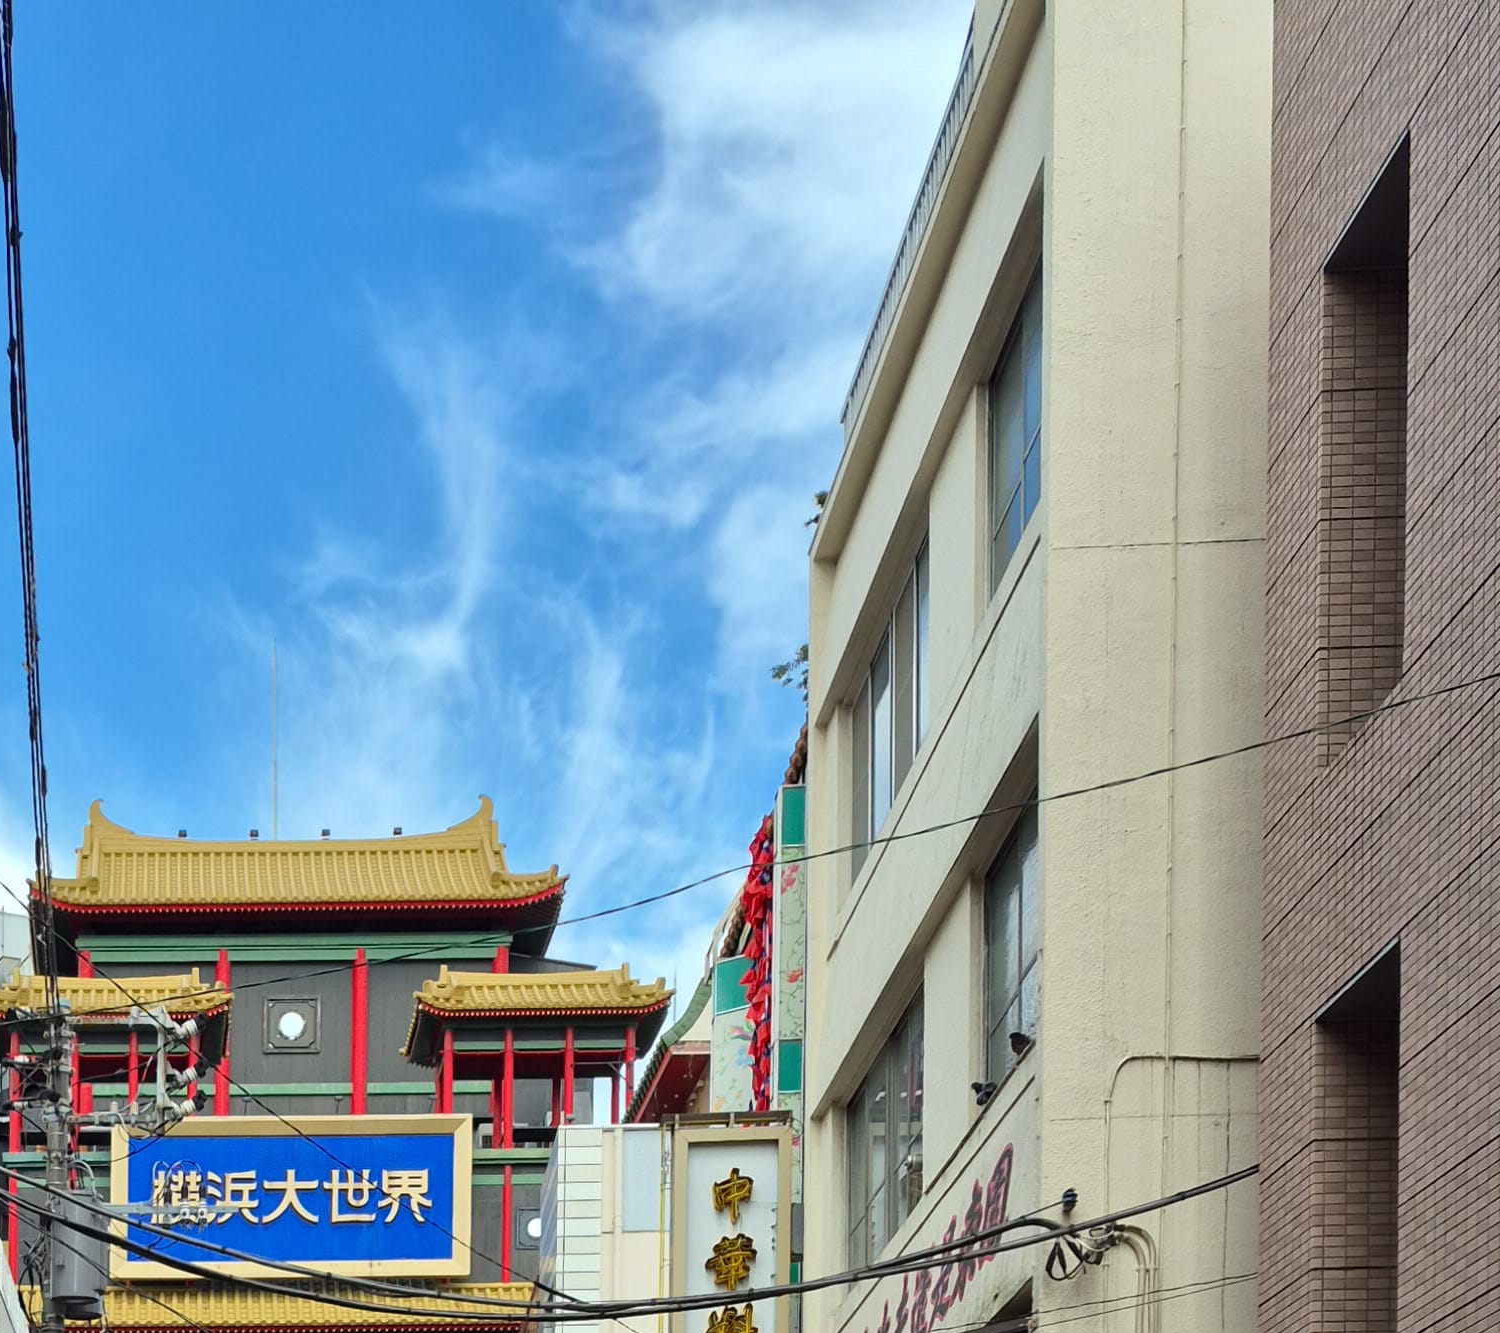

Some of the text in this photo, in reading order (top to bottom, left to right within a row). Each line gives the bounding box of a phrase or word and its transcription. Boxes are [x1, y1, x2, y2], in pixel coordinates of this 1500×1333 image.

[150, 1168, 433, 1226] 横浜大世界
